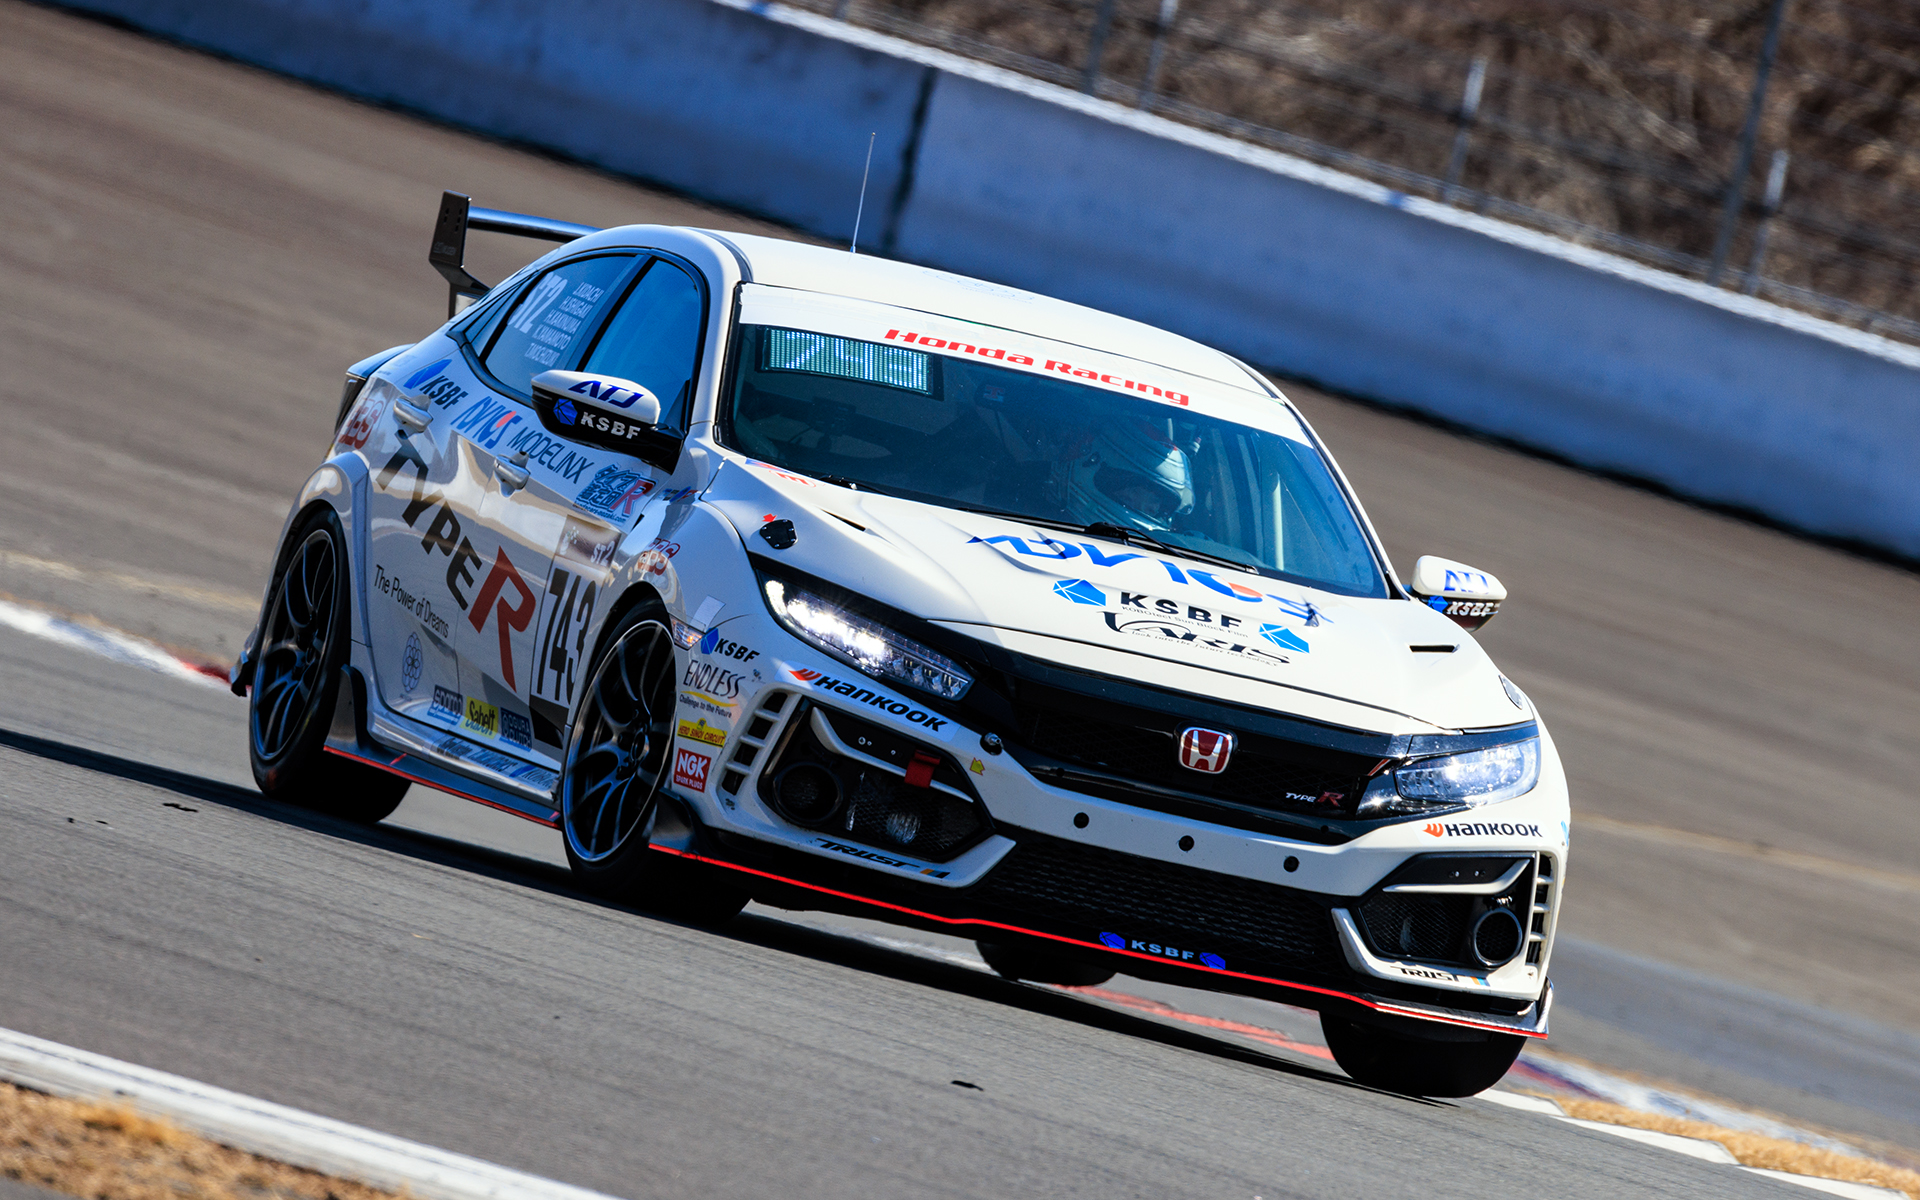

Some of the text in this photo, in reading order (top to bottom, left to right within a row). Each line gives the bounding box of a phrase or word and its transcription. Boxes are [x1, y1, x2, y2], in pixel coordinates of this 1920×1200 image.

[507, 272, 568, 333] ST2
[785, 332, 926, 388] 743
[884, 329, 1189, 406] Honda Racing
[419, 375, 469, 410] KSBF
[450, 396, 523, 449] ADVICS
[580, 411, 641, 439] KSBF
[506, 426, 595, 484] MODELINX
[375, 428, 482, 611] TYPE
[468, 545, 536, 693] R
[590, 540, 615, 567] ST2
[966, 535, 1334, 624] ADVICS
[374, 564, 449, 638] The Power of Dreams
[1121, 591, 1242, 629] KSBF
[1447, 600, 1496, 617] KSBF
[536, 568, 596, 705] 743
[1174, 614, 1195, 626] Sun
[1196, 620, 1226, 632] Block
[1228, 628, 1249, 639] Film
[1176, 637, 1191, 646] the
[714, 638, 760, 662] KSBF
[683, 660, 746, 699] ENDLESS
[680, 694, 732, 718] Challenge to the Future
[677, 752, 708, 779] NGK
[689, 778, 703, 790] PLUGS
[1285, 791, 1345, 806] TYPE R
[816, 838, 920, 868] TRUST
[1131, 940, 1194, 960] KSBF
[1390, 966, 1460, 982] TRUST
